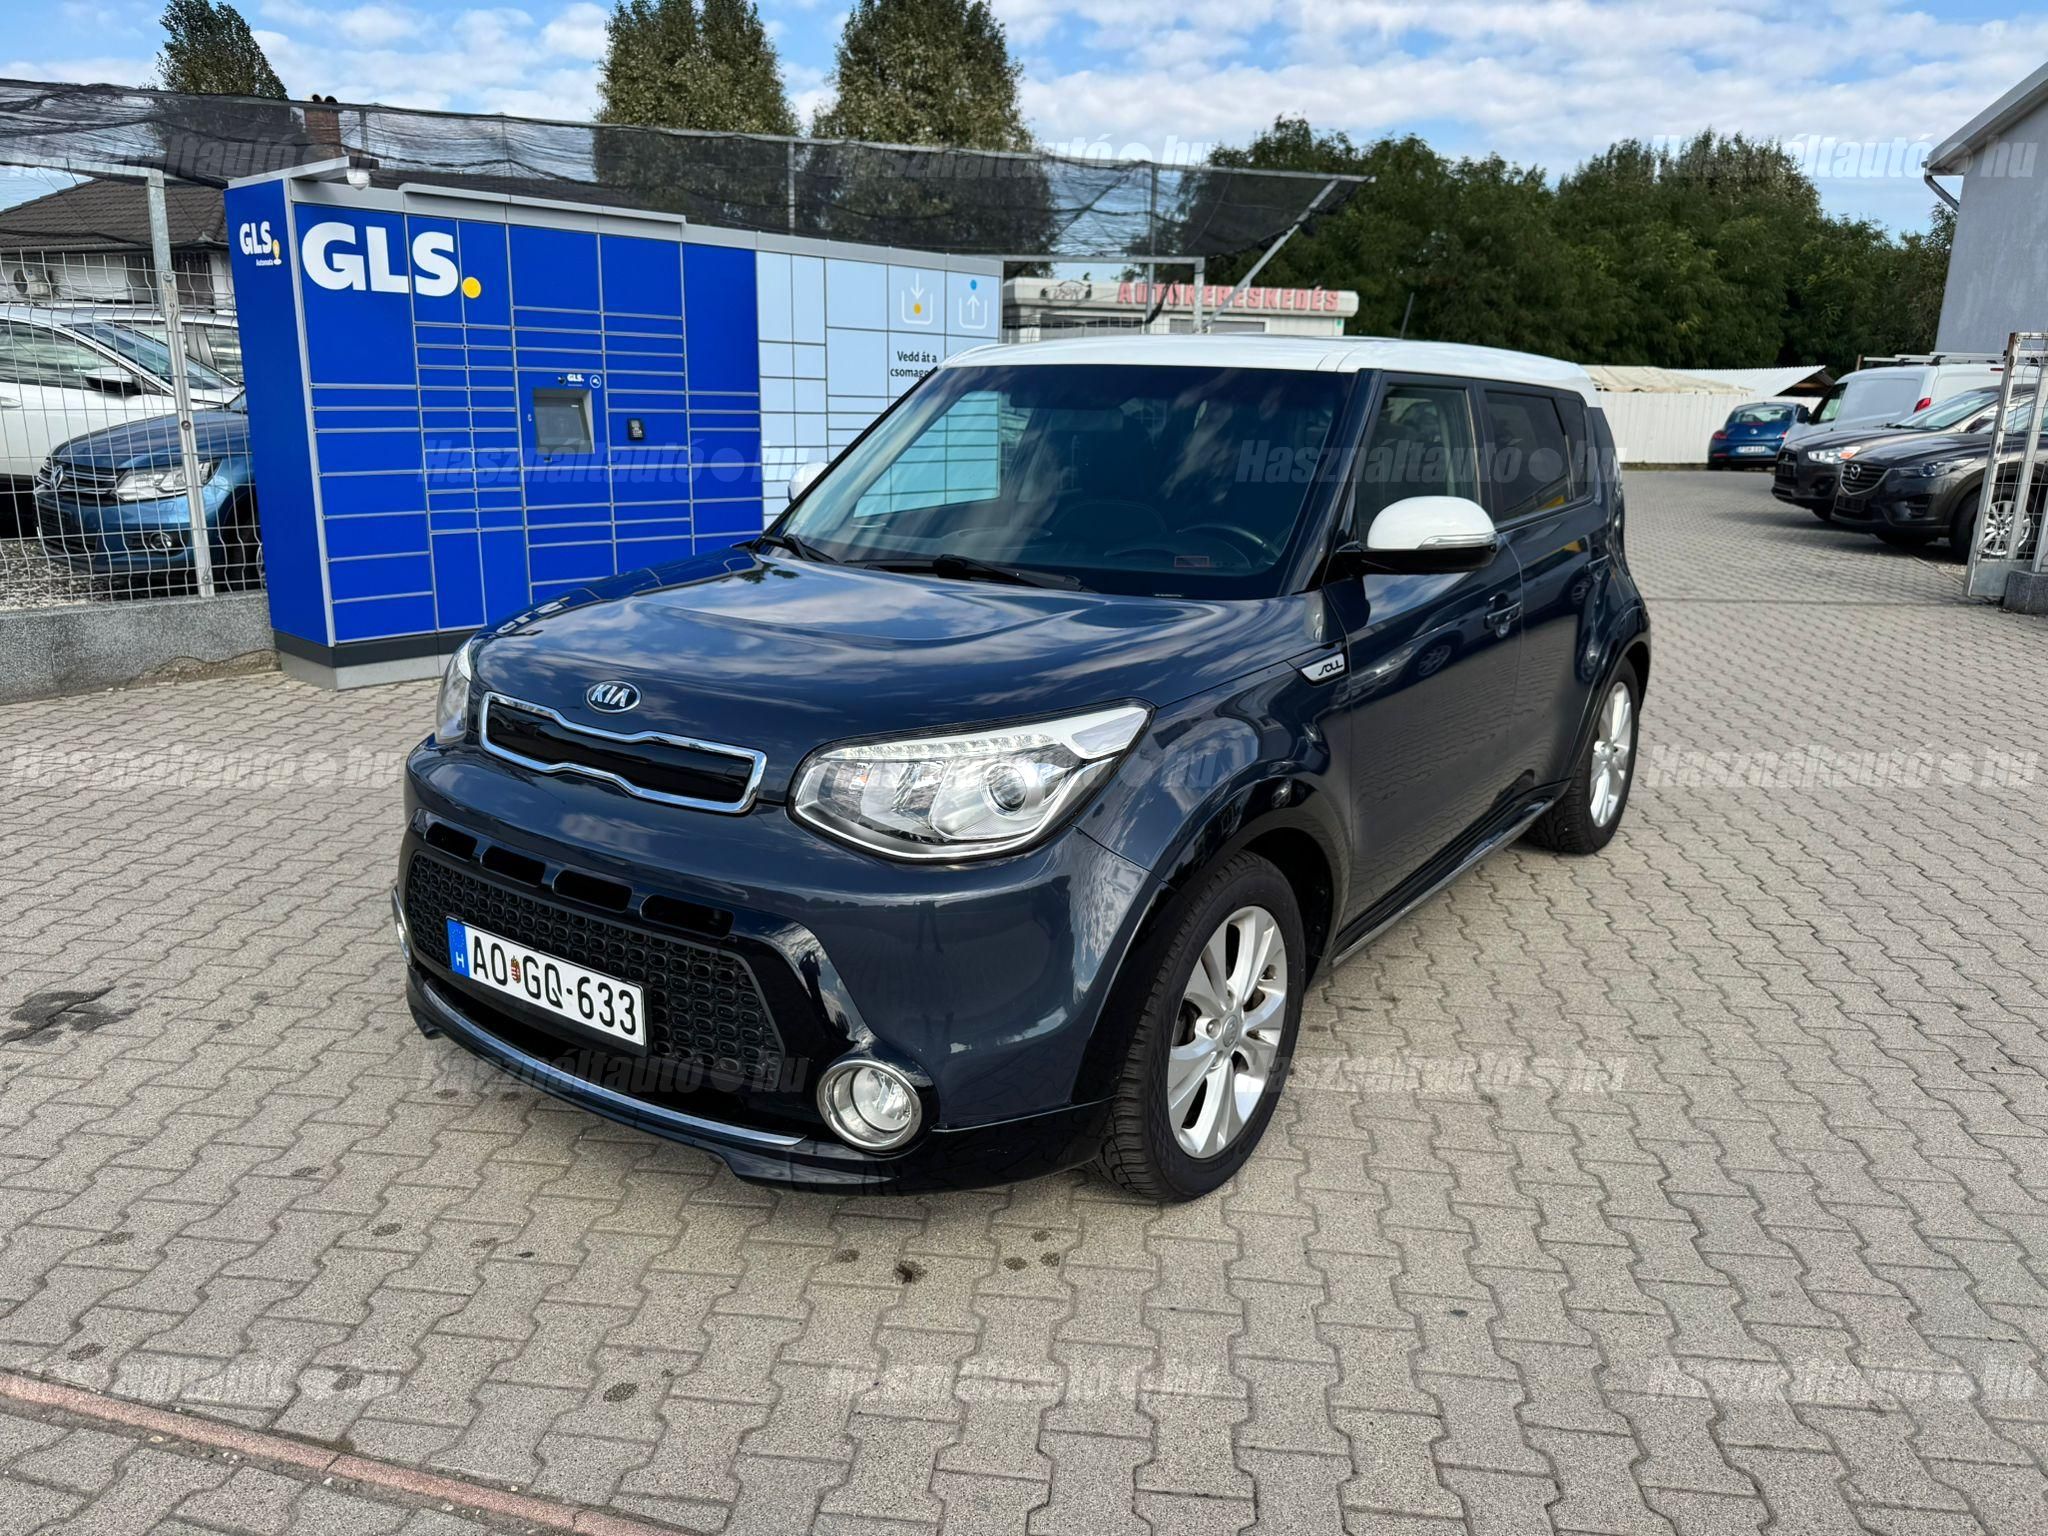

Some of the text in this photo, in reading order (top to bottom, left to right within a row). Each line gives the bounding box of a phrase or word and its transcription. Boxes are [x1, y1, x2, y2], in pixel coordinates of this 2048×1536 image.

[897, 350, 938, 363] Vedd át a
[591, 684, 630, 707] KIA
[455, 952, 465, 968] H
